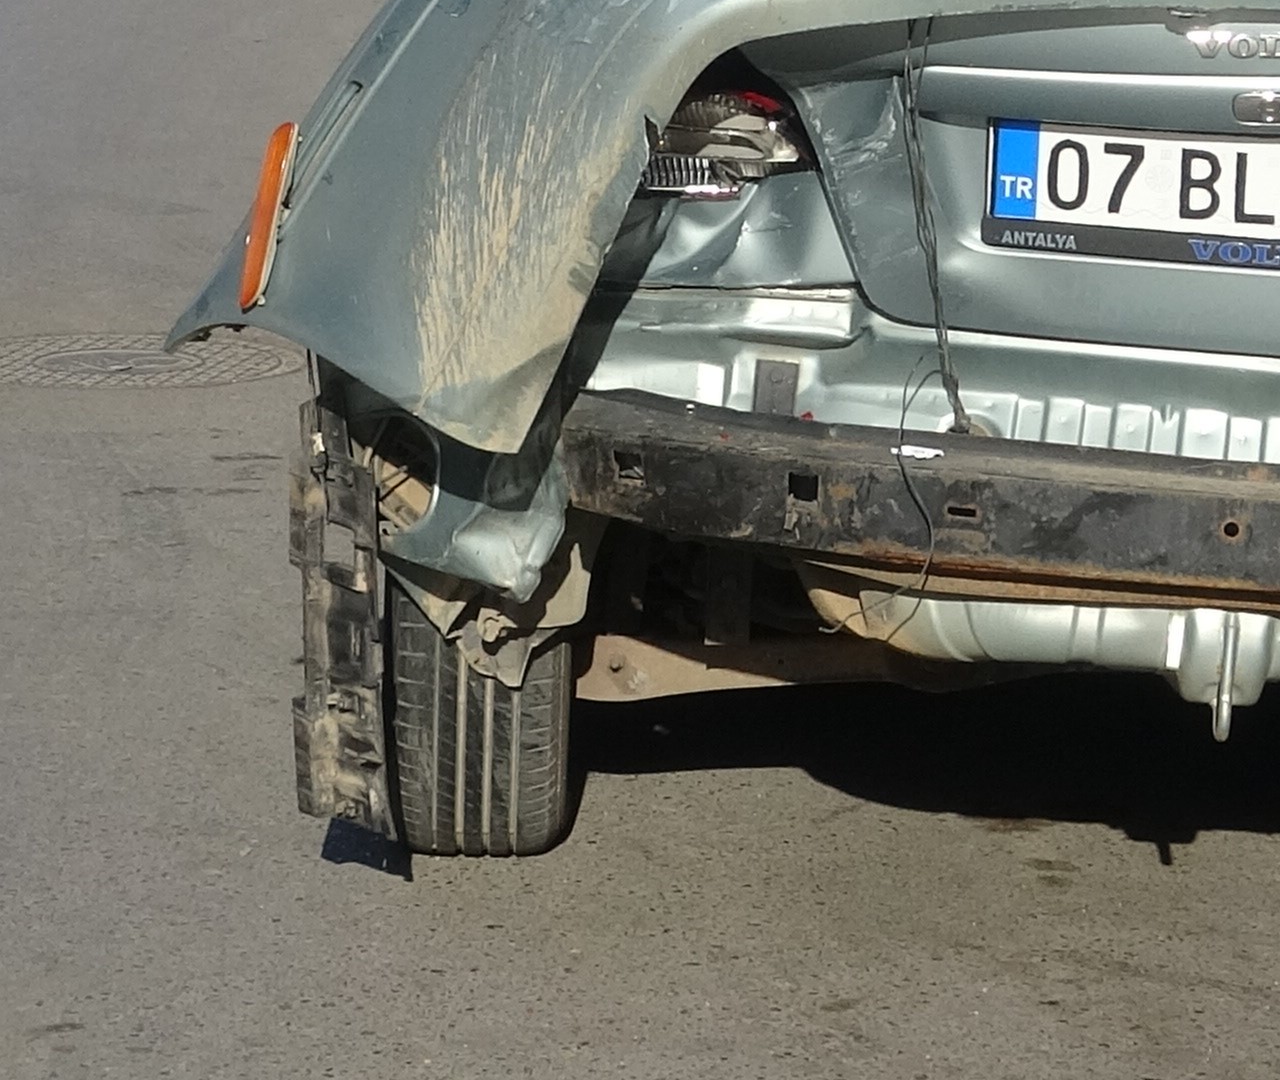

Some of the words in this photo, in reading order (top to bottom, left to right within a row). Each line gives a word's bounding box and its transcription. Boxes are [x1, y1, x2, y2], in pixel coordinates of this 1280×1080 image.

[1000, 175, 1032, 199] TR
[1046, 138, 1146, 213] 07
[1000, 230, 1077, 251] ANTALYA
